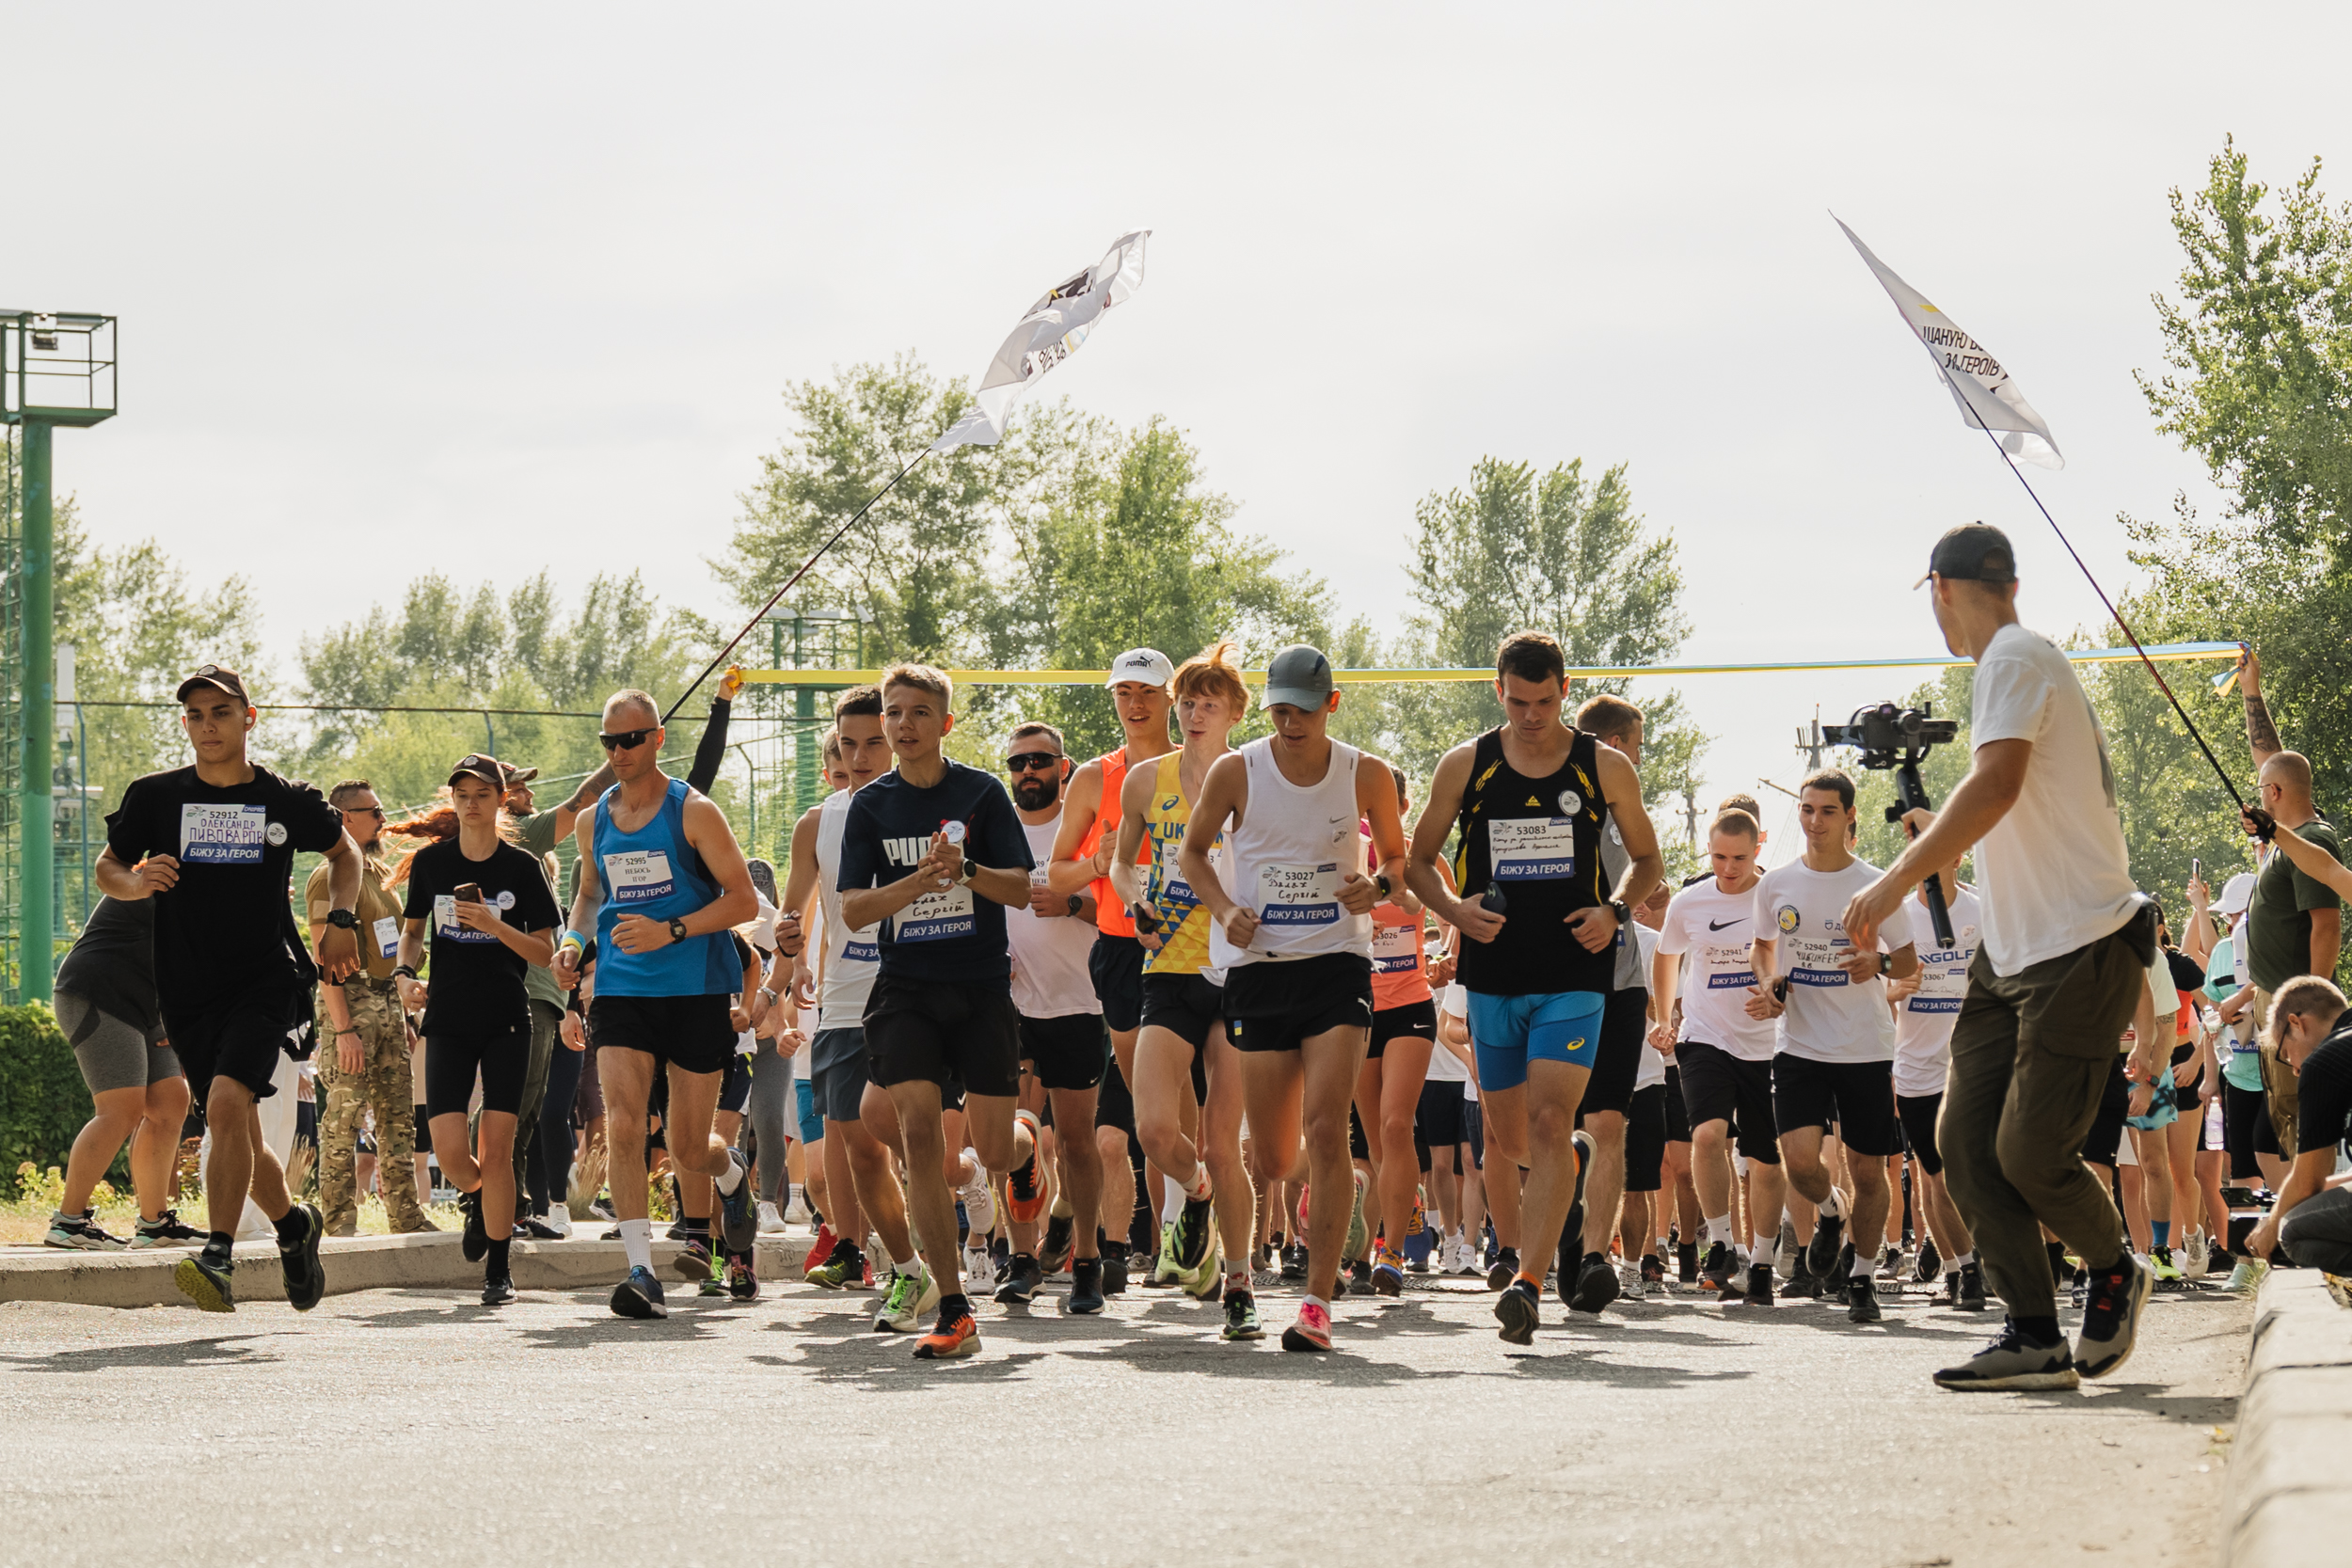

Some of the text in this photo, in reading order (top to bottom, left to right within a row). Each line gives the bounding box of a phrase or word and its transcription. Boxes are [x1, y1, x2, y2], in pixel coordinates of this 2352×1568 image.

[209, 811, 238, 819] 52912
[200, 818, 256, 830] ОЛЕКСАНДР
[1517, 826, 1547, 835] 53083
[189, 828, 264, 845] ПИВОВАРОВ
[189, 847, 260, 858] БІЖУ ЗА ГЕРОЯ
[625, 857, 646, 865] 52995
[1500, 863, 1570, 875] БІЖУ ЗА ГЕРОЯ
[1285, 871, 1314, 880] 53027
[619, 884, 672, 899] БІЖУ ЗА ГЕРОЯ
[1170, 886, 1191, 897] БІЖУ
[1267, 909, 1335, 920] БІЖУ ЗА ГЕРОЯ
[903, 921, 972, 938] БІЖУ ЗА ГЕРОЯ
[849, 946, 868, 956] БІЖУ
[1392, 958, 1414, 968] ГЕРОЯ
[1740, 975, 1758, 984] ГЕРО
[1793, 972, 1810, 980] БІЖУ
[1810, 974, 1820, 982] ЗА
